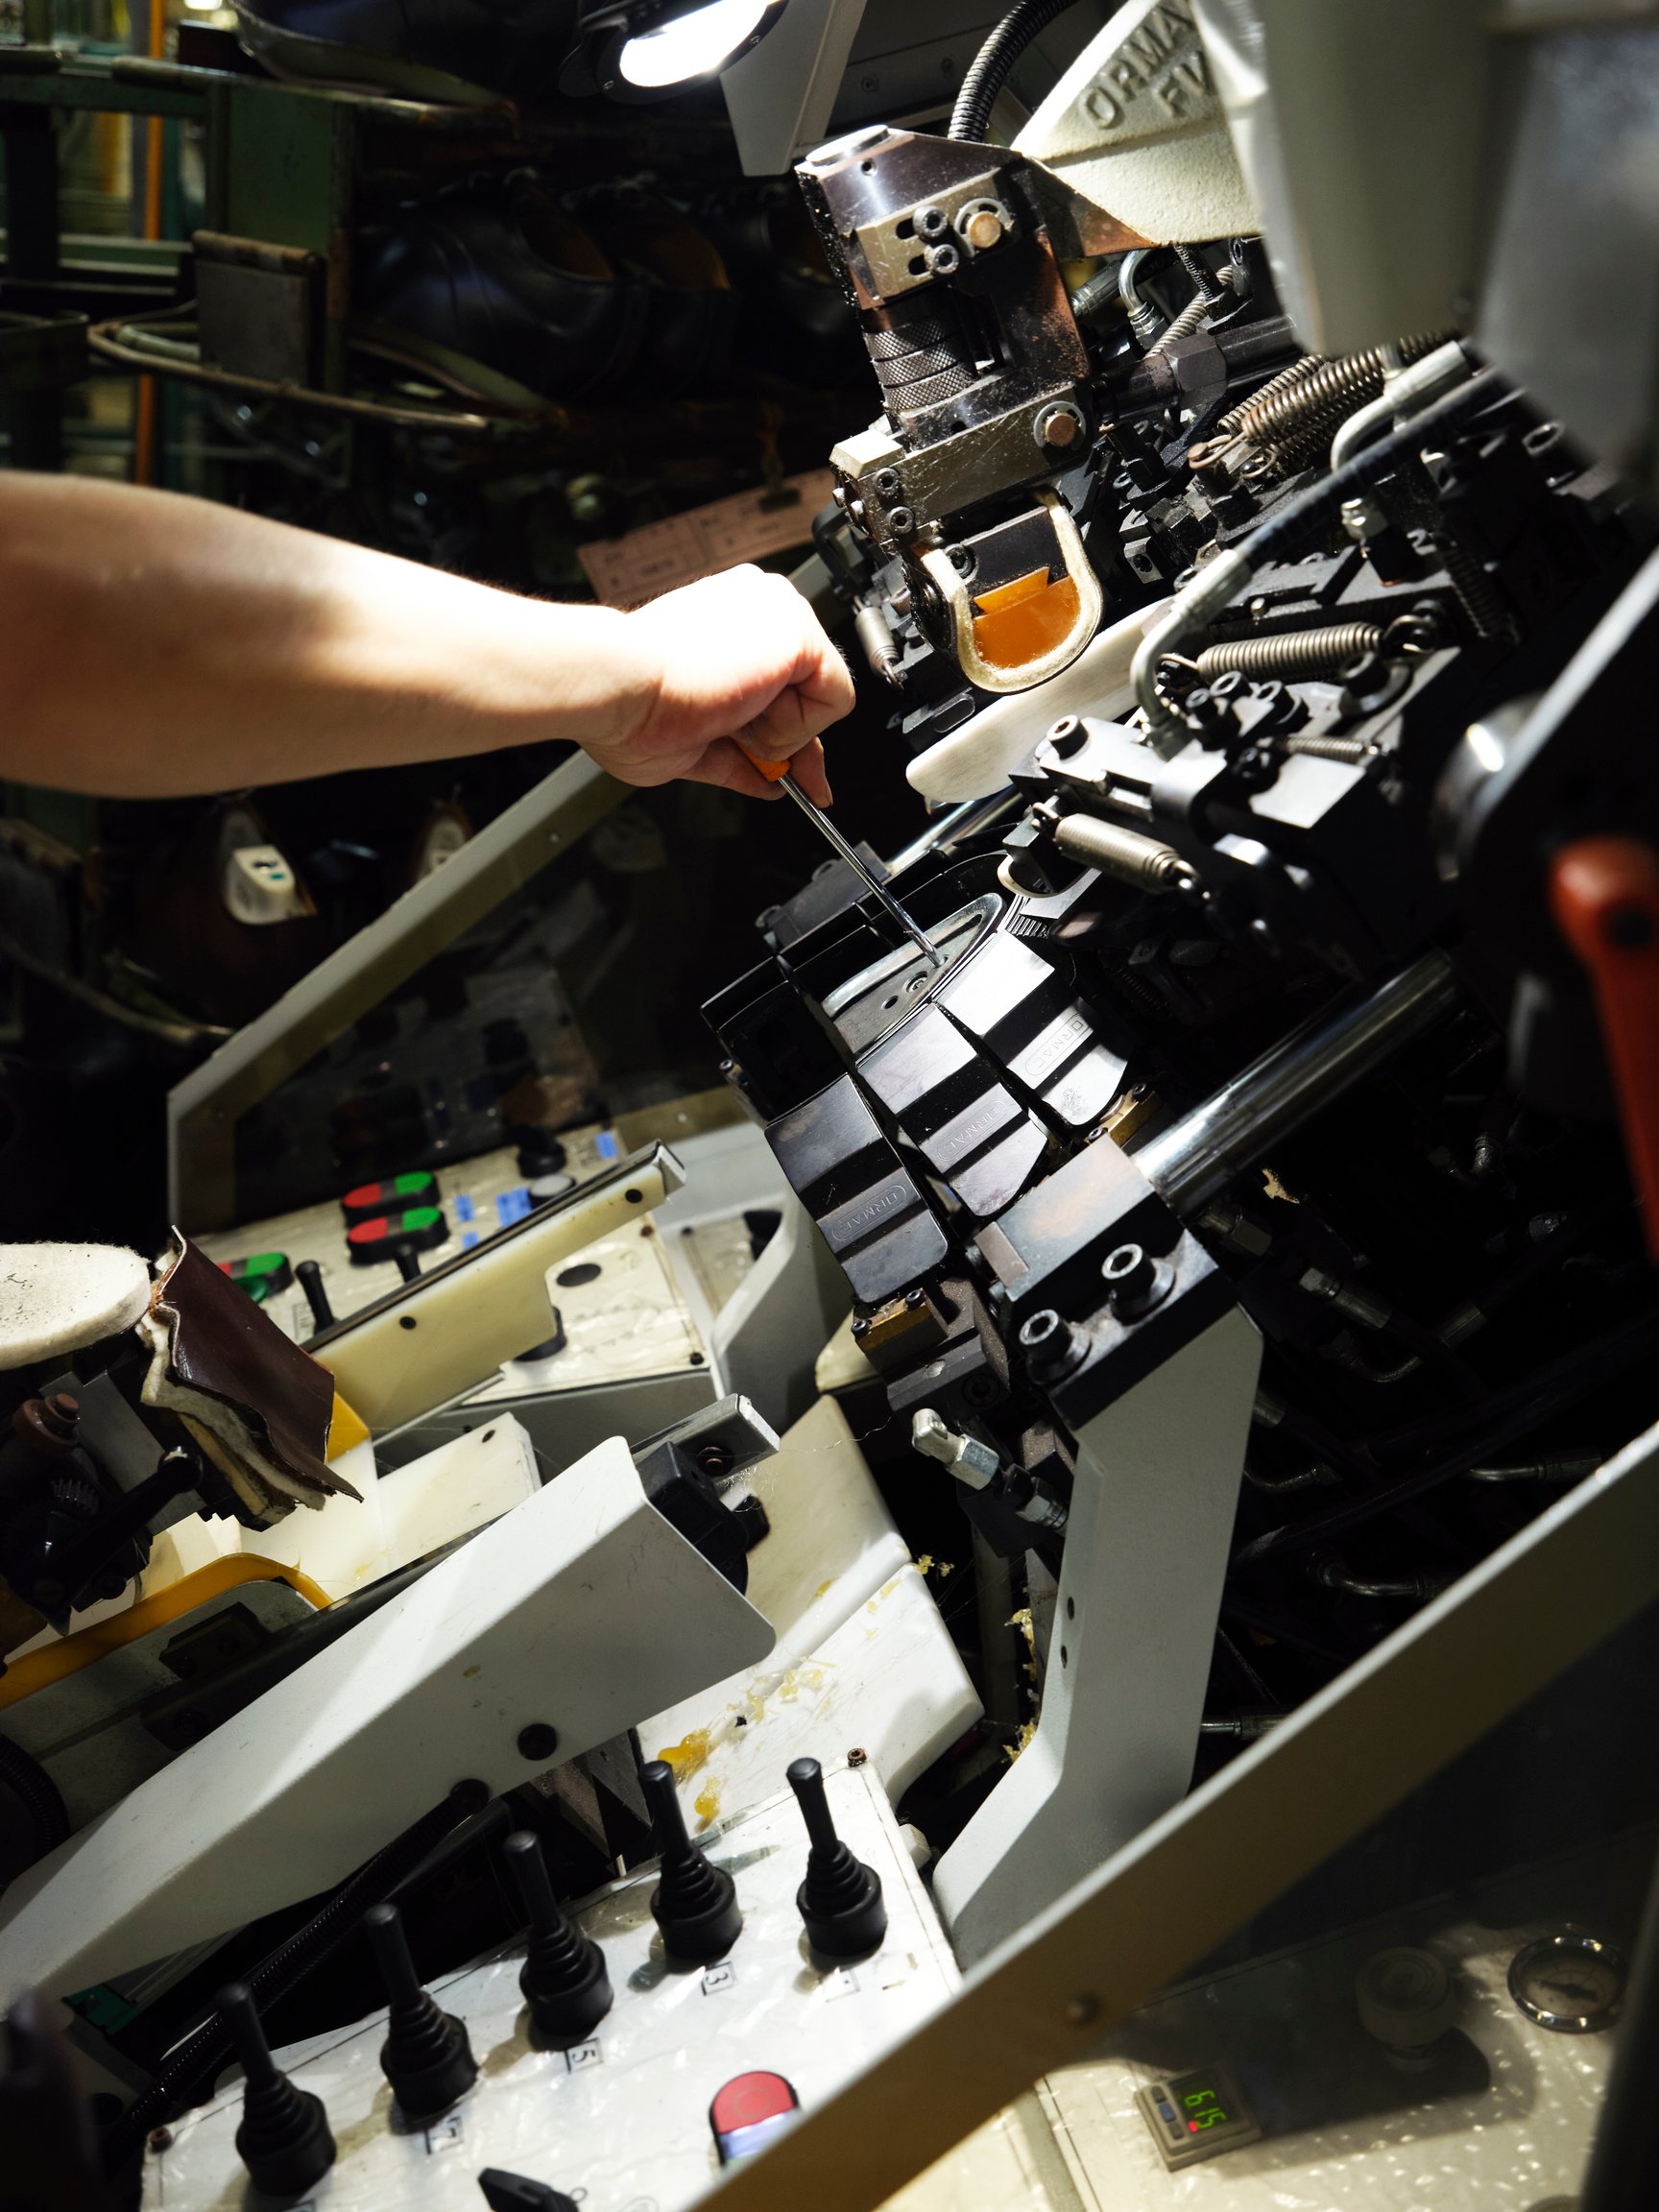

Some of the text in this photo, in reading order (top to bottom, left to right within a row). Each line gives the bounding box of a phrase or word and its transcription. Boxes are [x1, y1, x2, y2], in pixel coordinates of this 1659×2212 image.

[1032, 1020, 1084, 1069] ORMAC
[944, 1106, 999, 1153] ORMAC
[839, 1192, 899, 1232] ORMAC
[705, 1972, 729, 1985] 3
[572, 2049, 596, 2064] 5
